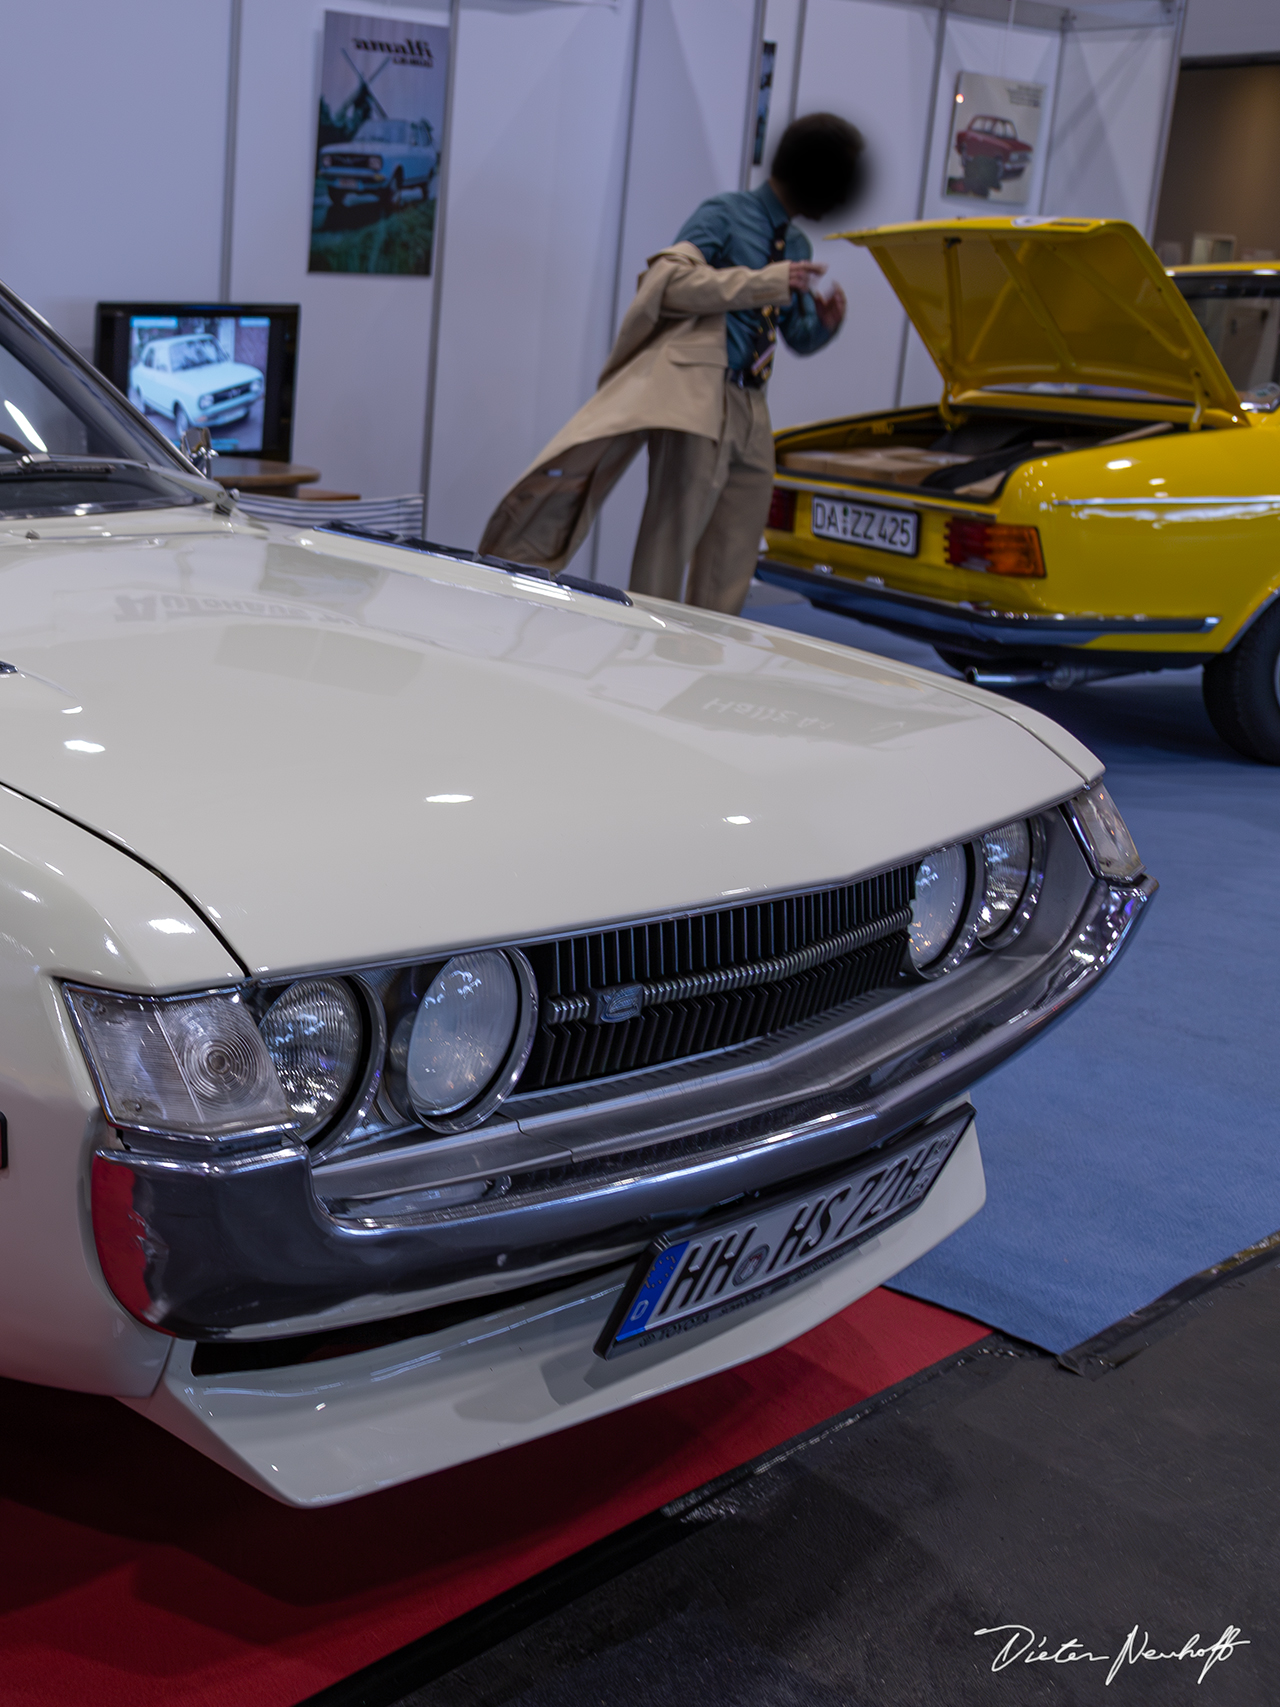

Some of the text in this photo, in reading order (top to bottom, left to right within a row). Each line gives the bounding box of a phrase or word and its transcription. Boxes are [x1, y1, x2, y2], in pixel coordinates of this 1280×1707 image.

[814, 503, 911, 547] DA ZZ 425
[656, 1222, 757, 1316] HH
[767, 1186, 852, 1273] HS
[835, 1143, 934, 1238] 72H
[630, 1298, 648, 1322] D
